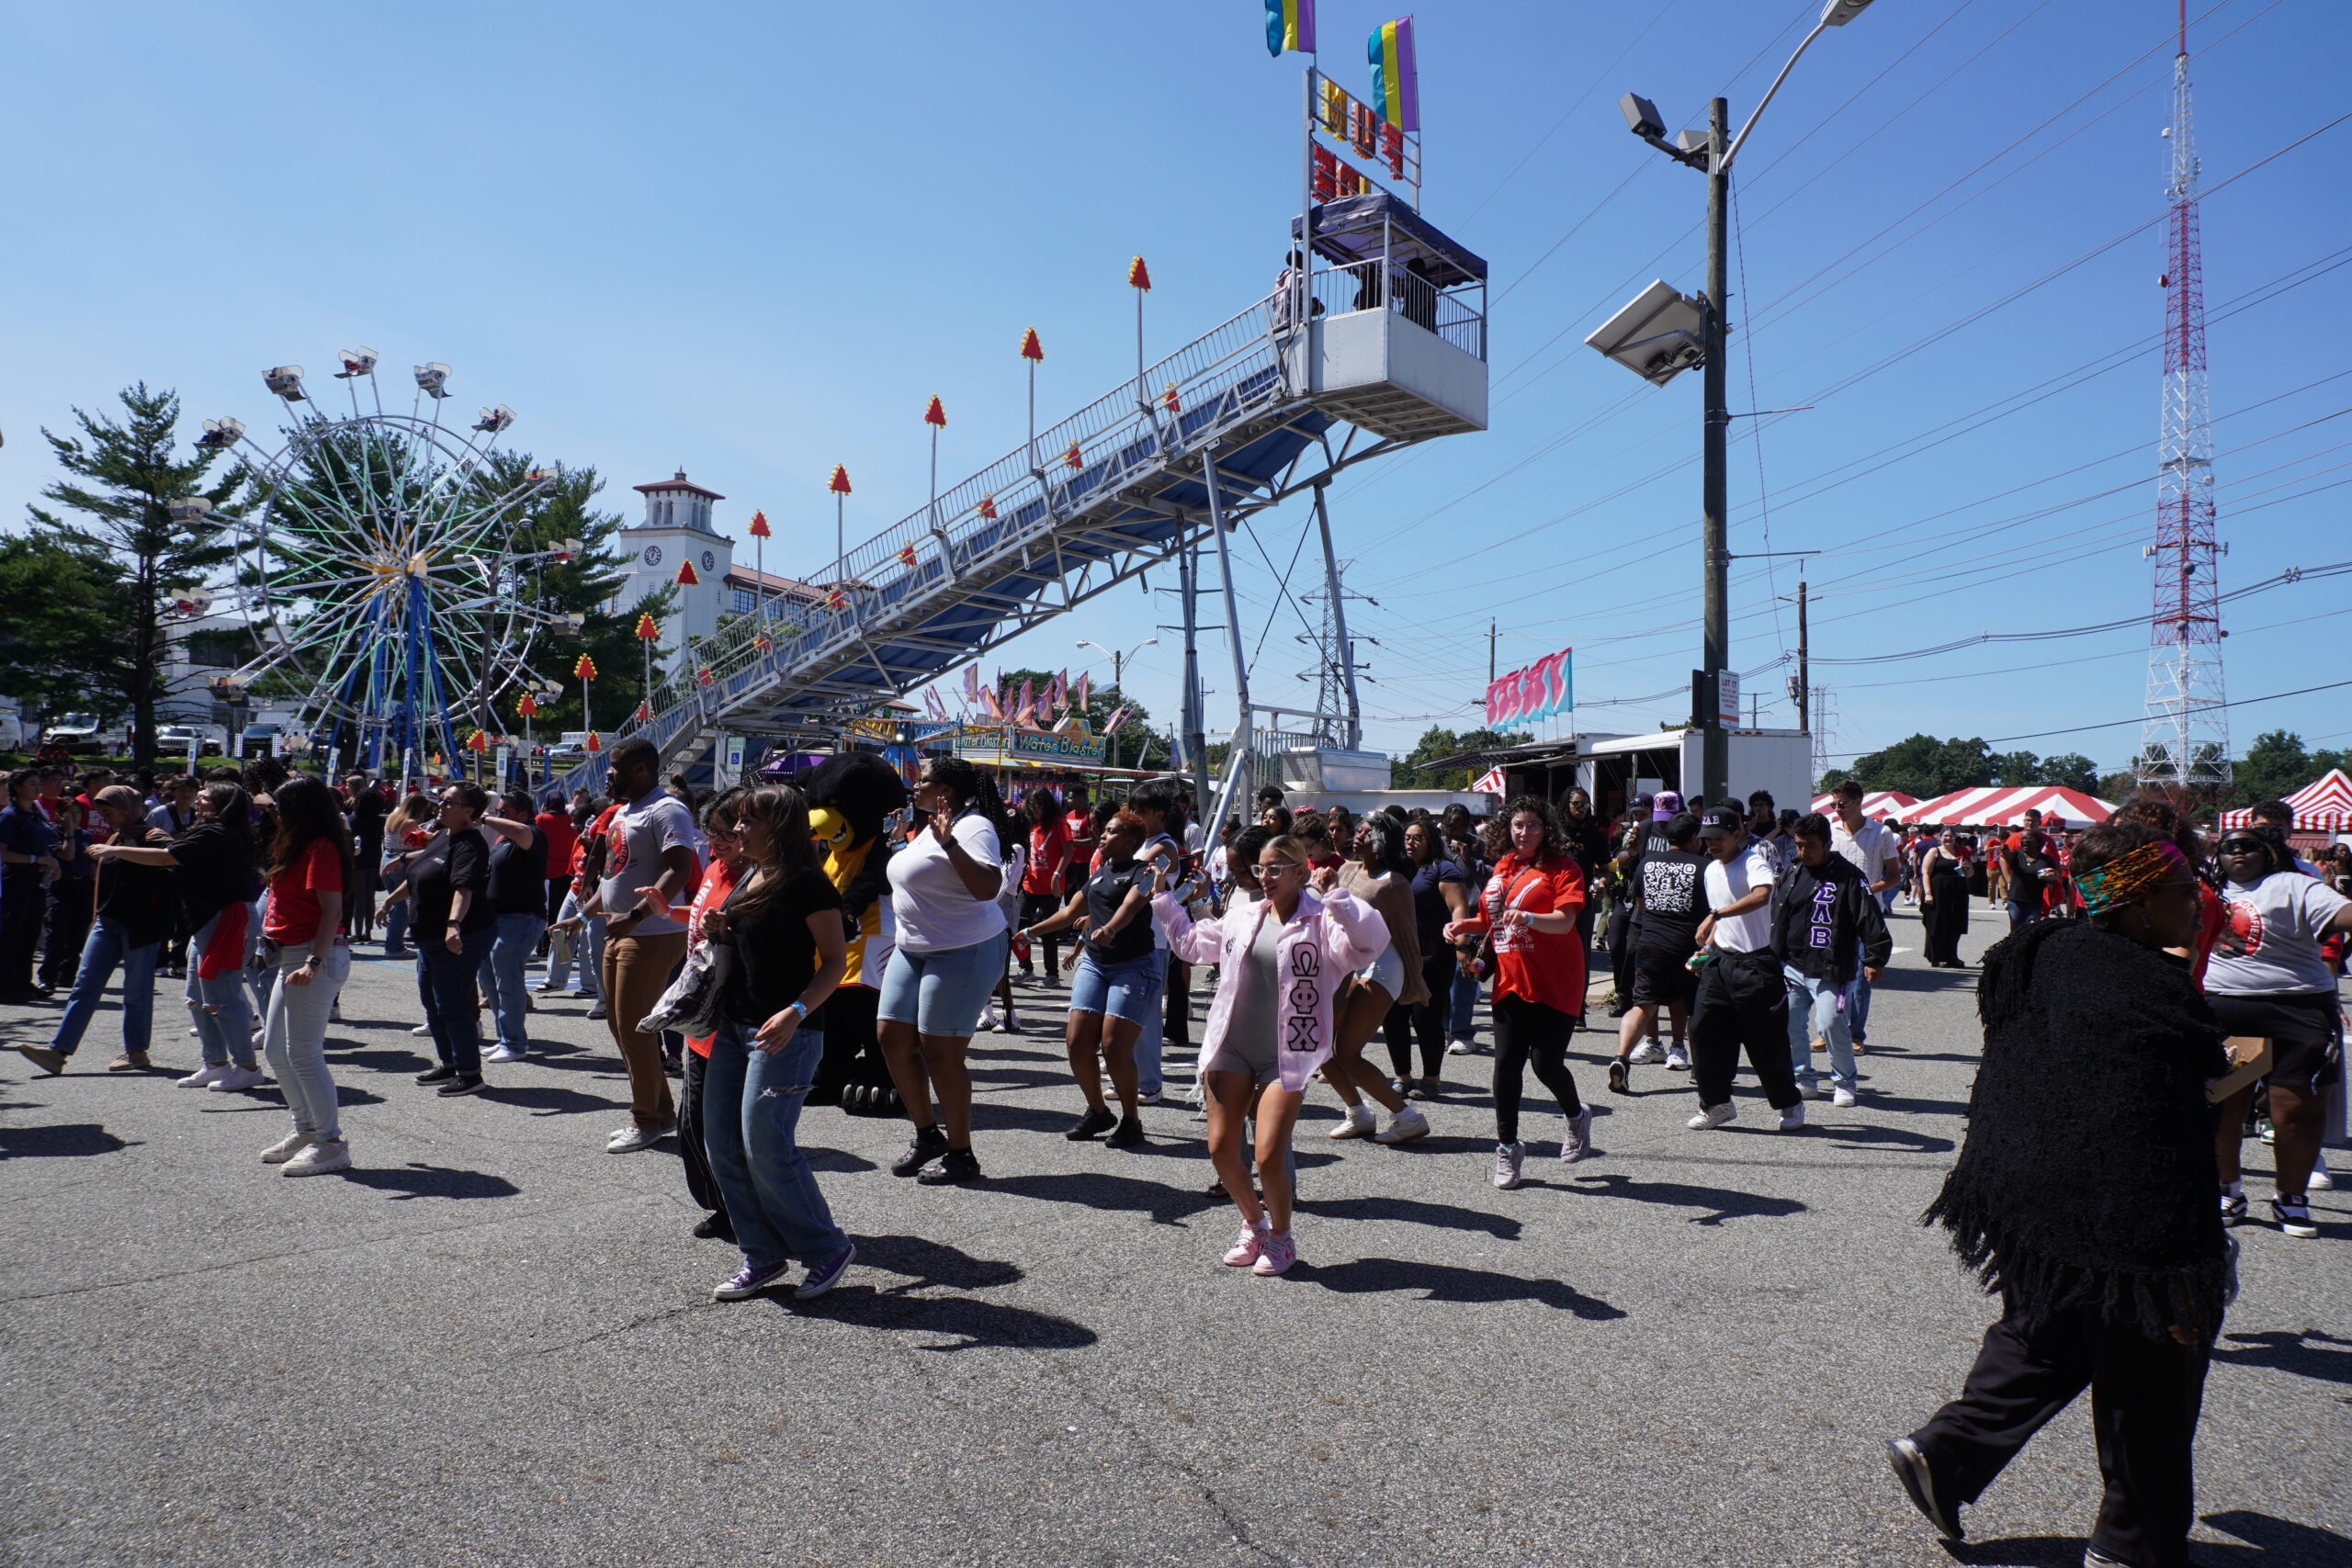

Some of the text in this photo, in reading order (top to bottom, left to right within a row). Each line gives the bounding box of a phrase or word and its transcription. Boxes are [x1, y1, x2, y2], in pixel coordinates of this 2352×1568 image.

[1020, 735, 1104, 757] Water Blaster
[693, 878, 714, 906] DAY
